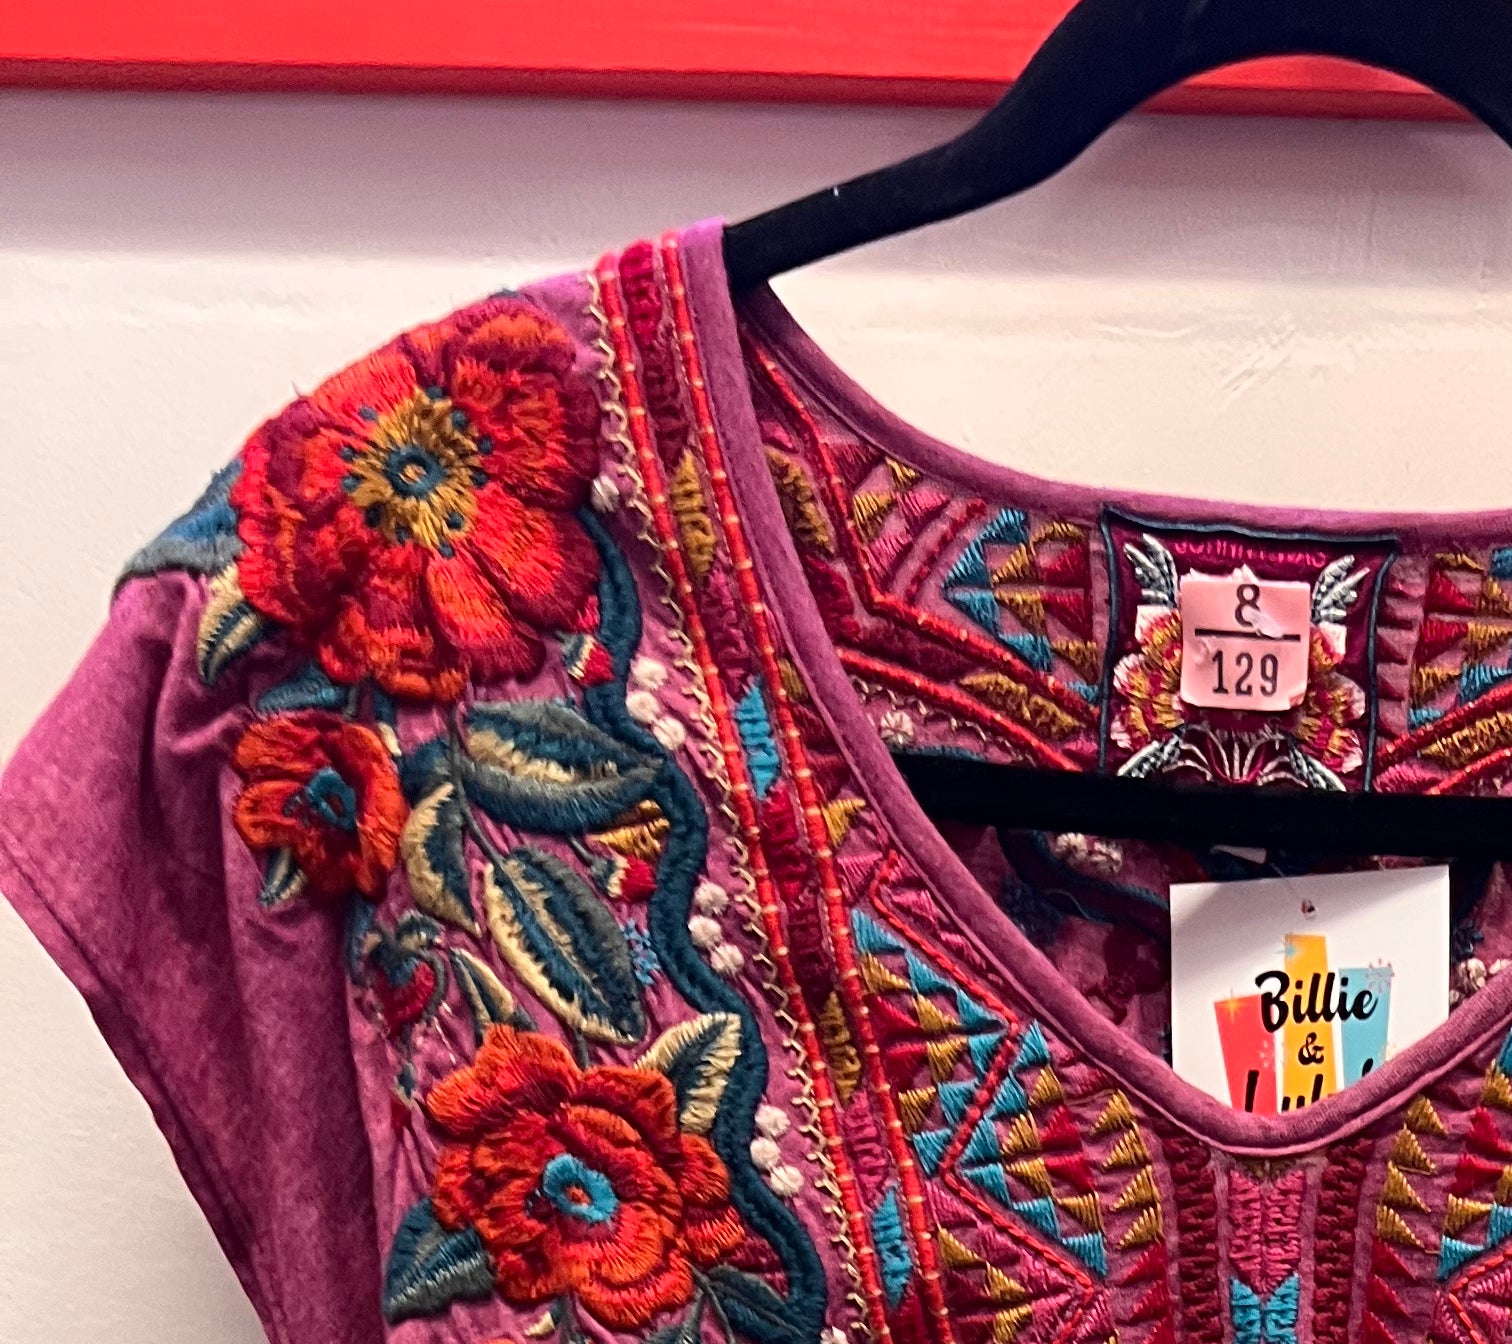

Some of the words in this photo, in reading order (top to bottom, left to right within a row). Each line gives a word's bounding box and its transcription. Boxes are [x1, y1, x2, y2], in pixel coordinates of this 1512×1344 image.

[1235, 583, 1261, 627] 8
[1211, 650, 1279, 697] 129
[1254, 970, 1379, 1033] Billie
[1298, 1032, 1325, 1066] &
